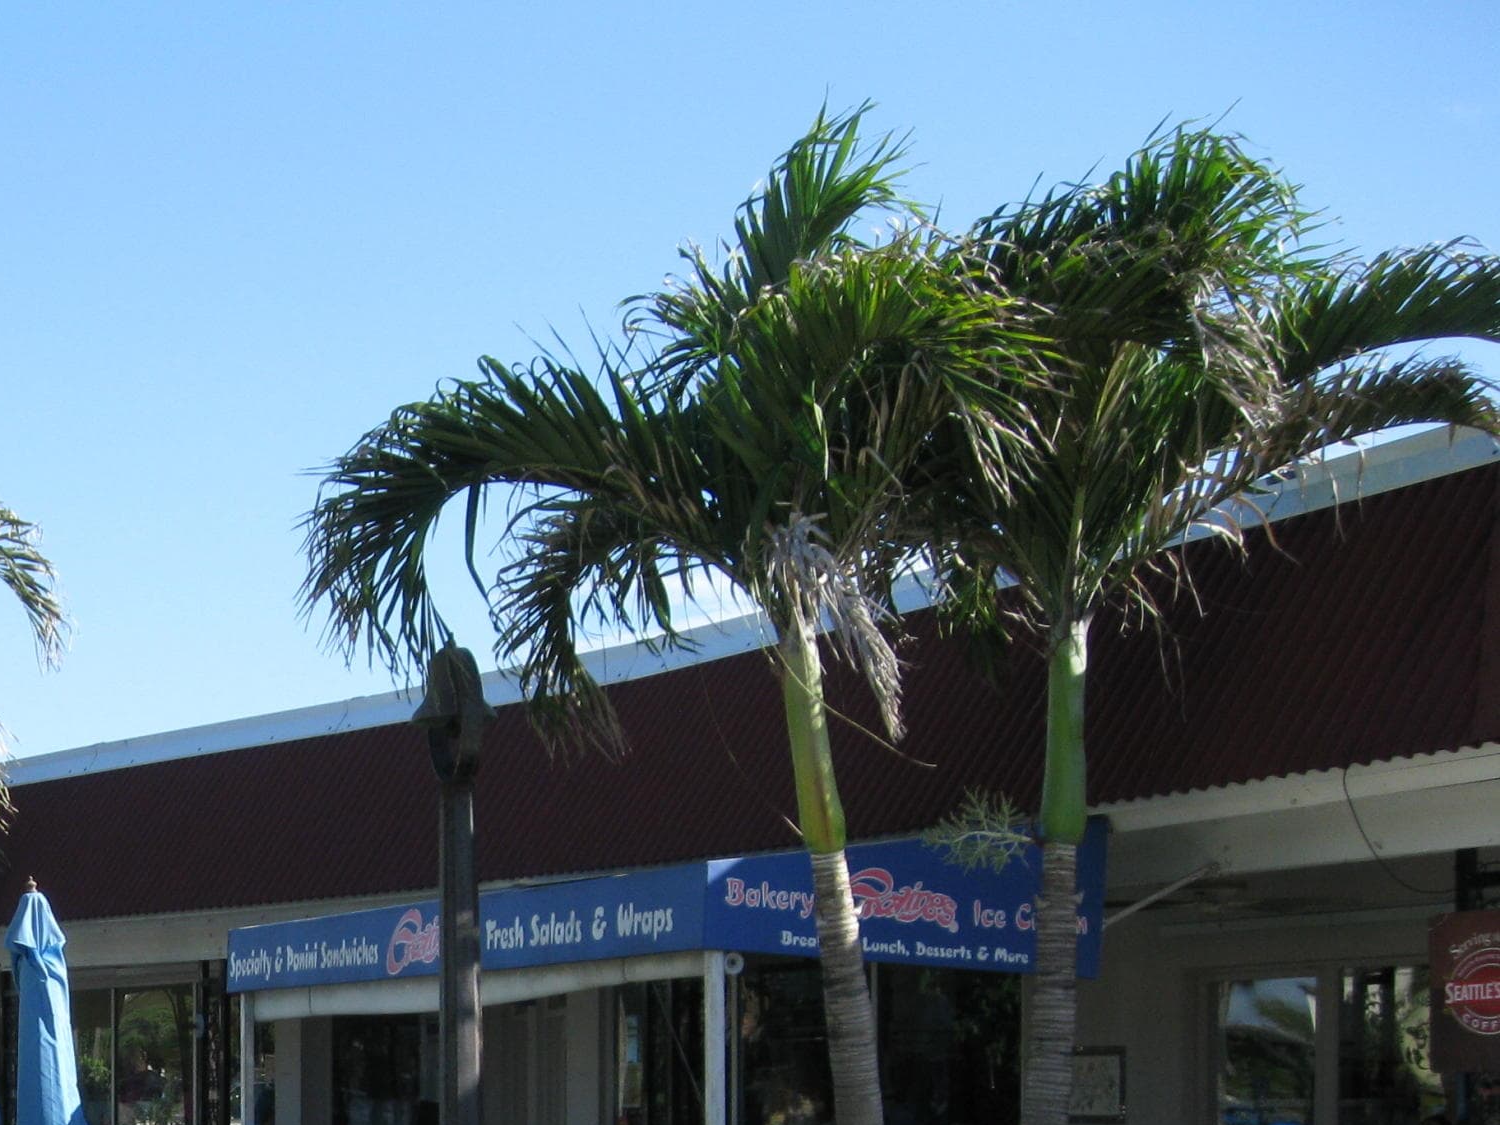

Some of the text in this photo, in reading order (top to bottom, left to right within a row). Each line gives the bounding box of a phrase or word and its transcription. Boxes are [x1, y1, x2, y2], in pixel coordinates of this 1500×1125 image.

[725, 877, 814, 918] Bakery
[973, 900, 1005, 928] Ice
[486, 903, 674, 951] Fresh Salads & Wraps
[230, 937, 379, 981] Specialty & Panini Sandwiches
[863, 937, 910, 957] Lunch,
[916, 942, 972, 961] Desserts
[977, 946, 988, 961] &
[995, 948, 1029, 964] More
[1462, 1012, 1500, 1031] COFF
